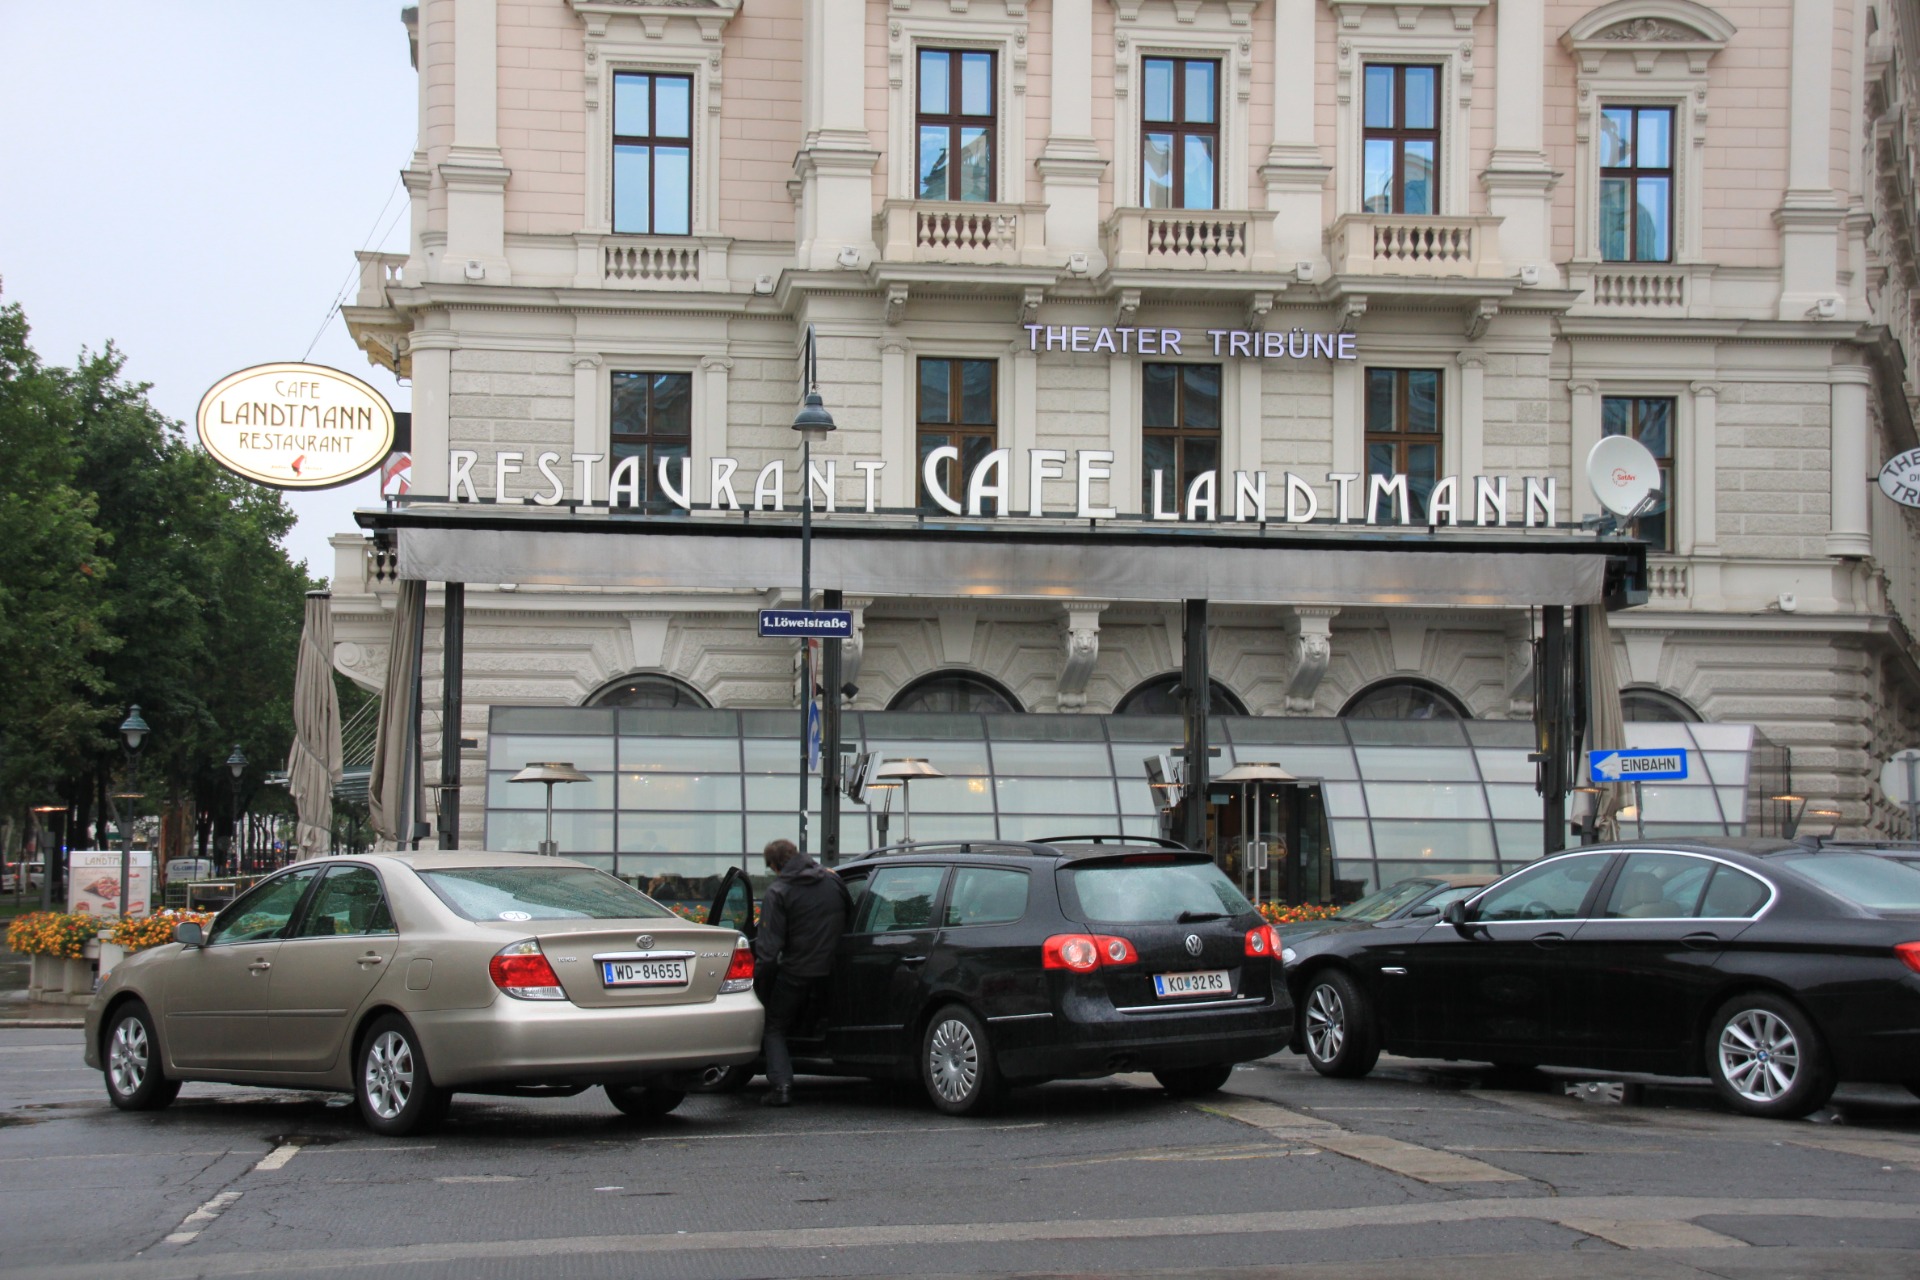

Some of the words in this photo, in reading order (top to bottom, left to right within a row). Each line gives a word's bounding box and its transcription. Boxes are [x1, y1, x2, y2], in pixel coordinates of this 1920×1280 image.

[1023, 324, 1182, 355] THEATER
[1207, 327, 1358, 360] TRIBÜNE
[275, 380, 320, 399] CAFE
[220, 400, 372, 431] LANDTMANN
[239, 432, 353, 453] RESTAURANT
[448, 449, 887, 513] RESTAURANT
[922, 445, 1118, 519] CAFE
[1152, 468, 1557, 528] LANDTMANN
[1621, 757, 1676, 772] EINBAHN
[85, 856, 138, 866] LANDTMN
[615, 963, 682, 980] WD-84655
